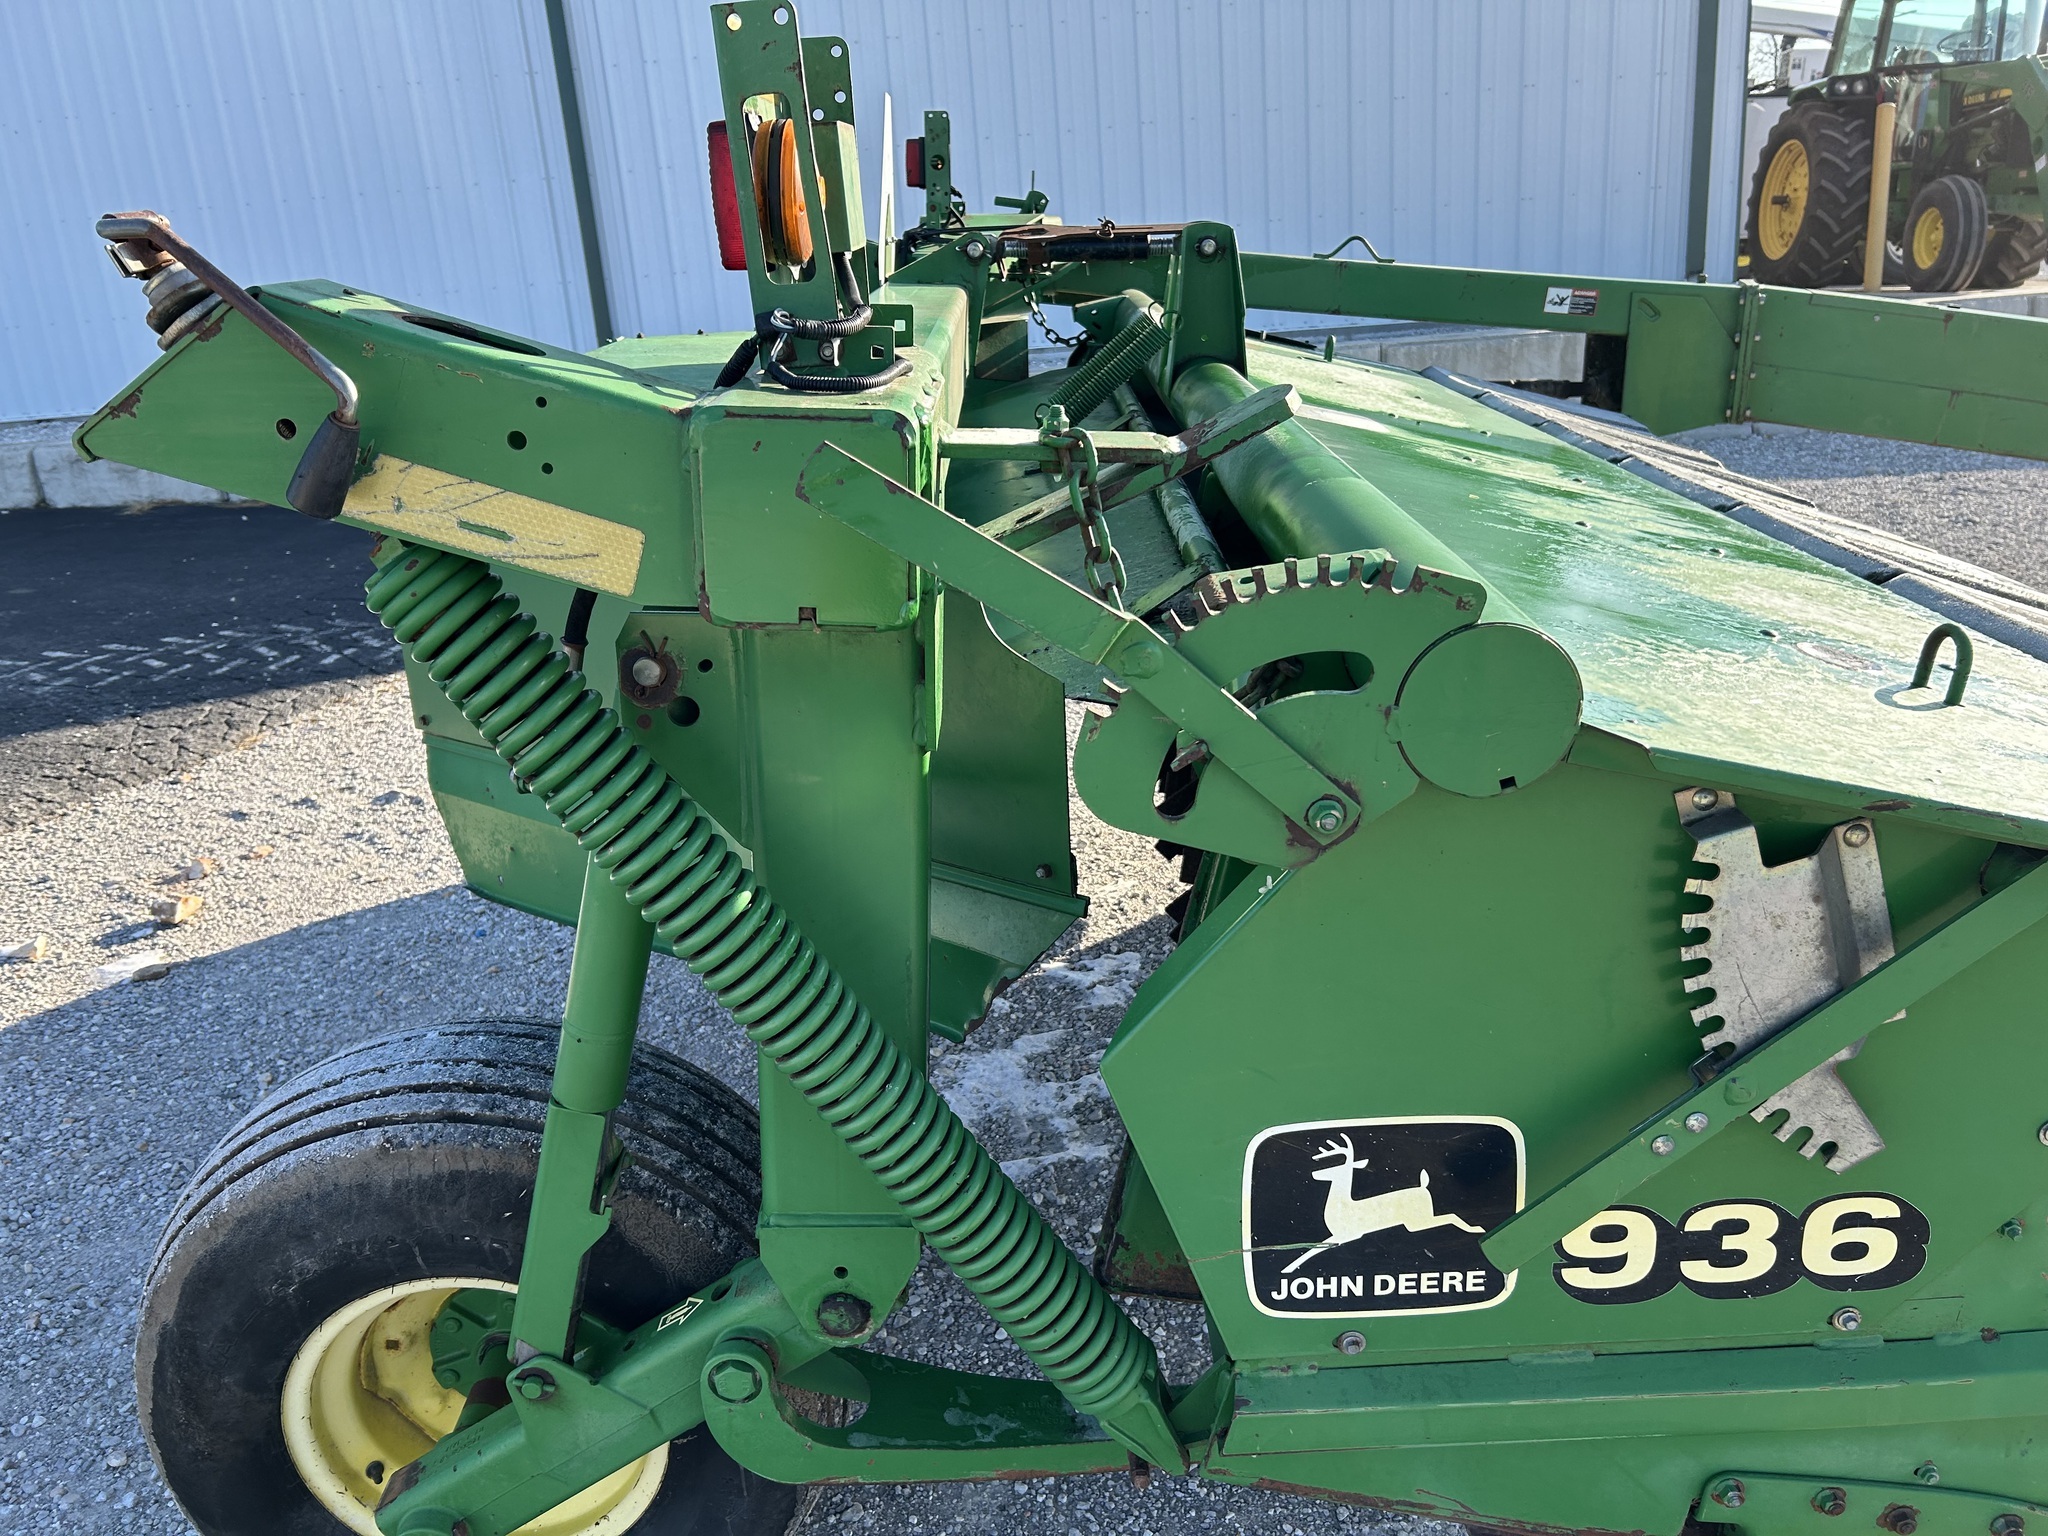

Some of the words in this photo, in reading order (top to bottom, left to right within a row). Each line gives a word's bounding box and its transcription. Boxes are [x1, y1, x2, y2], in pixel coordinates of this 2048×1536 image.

[1560, 1196, 1901, 1290] 936
[1271, 1275, 1364, 1300] JOHN
[1374, 1270, 1486, 1296] DEERE
